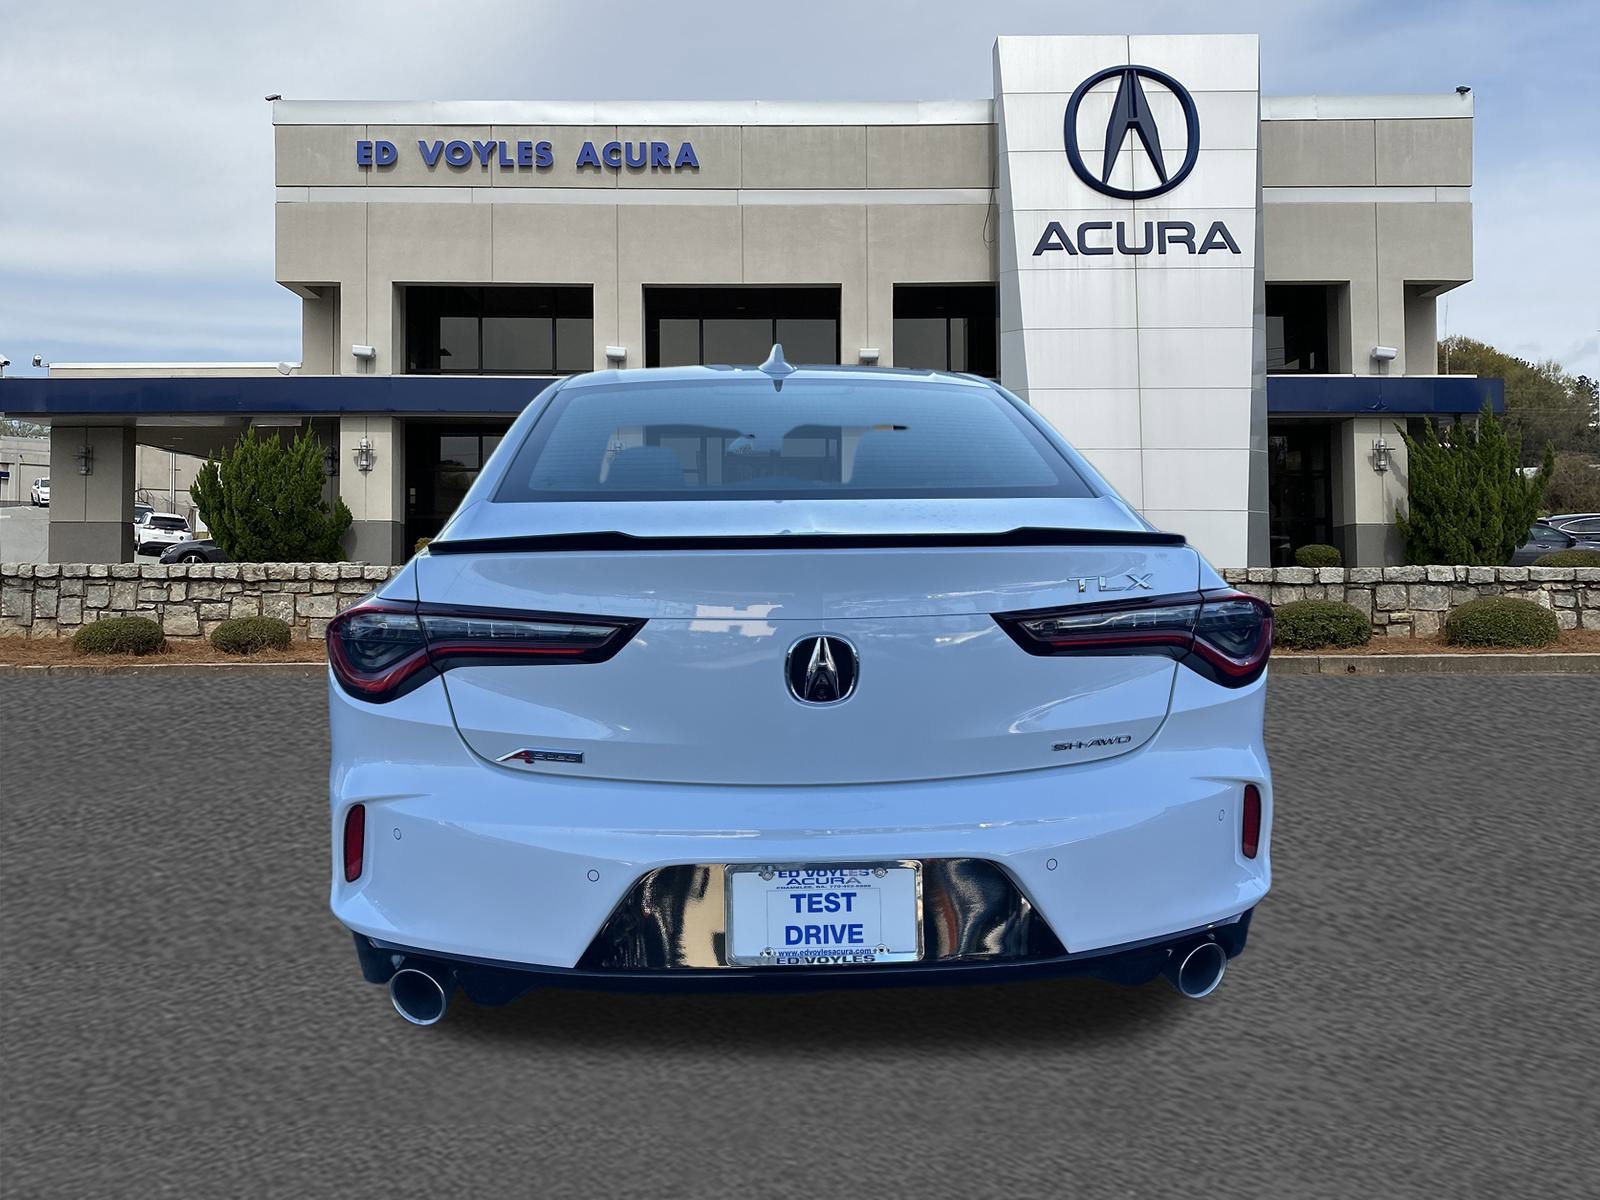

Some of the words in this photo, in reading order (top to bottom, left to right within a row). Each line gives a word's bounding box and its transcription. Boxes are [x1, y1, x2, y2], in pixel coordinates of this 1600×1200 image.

[356, 140, 398, 167] ED
[418, 140, 554, 168] VOYLES
[576, 141, 700, 168] ACURA
[1032, 221, 1242, 256] ACURA
[1066, 573, 1152, 593] TLX
[778, 870, 800, 878] ED
[805, 868, 870, 878] VOYLES
[786, 877, 862, 886] ACURA
[790, 892, 857, 913] TEST
[785, 924, 864, 945] DRIVE
[776, 956, 800, 965] ED
[805, 954, 876, 965] VOYLES
[778, 947, 872, 957] www.edvoylesacura.com
